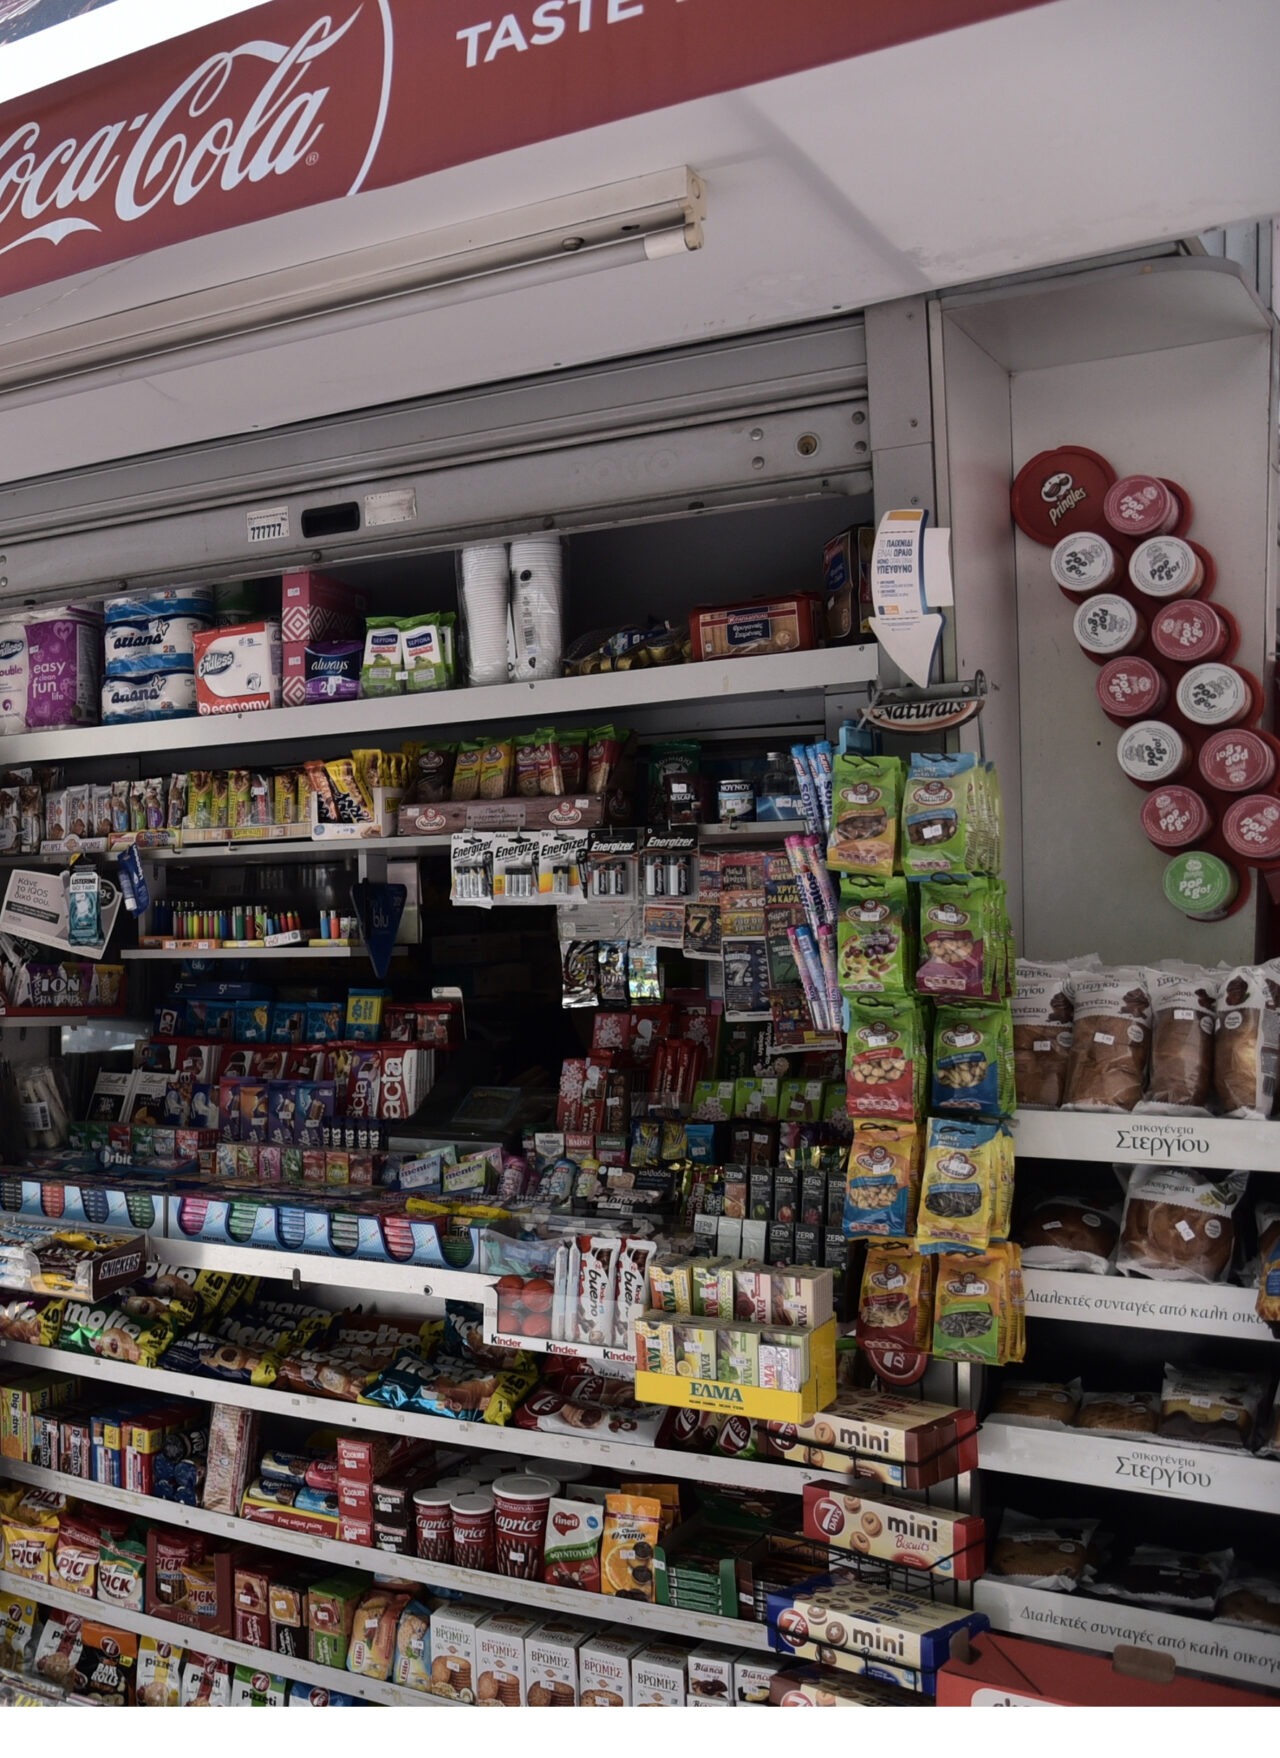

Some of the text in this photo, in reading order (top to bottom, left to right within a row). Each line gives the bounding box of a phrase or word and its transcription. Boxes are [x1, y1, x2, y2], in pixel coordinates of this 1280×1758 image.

[1049, 487, 1087, 526] Pringles
[877, 565, 913, 574] ΥΠΕΥΘΥΝΟ
[373, 636, 398, 645] SEPTONA
[406, 636, 432, 648] SEPTONA
[33, 661, 67, 677] easy
[198, 652, 234, 678] Endless
[311, 658, 350, 672] always
[33, 677, 57, 698] fun
[52, 692, 63, 700] life
[211, 700, 270, 714] economy
[452, 840, 494, 859] Energizer
[540, 837, 589, 857] Energizer
[590, 840, 635, 852] Energizer
[646, 836, 695, 849] Energizer
[18, 876, 39, 887] Κάνε
[14, 892, 31, 902] δικό
[27, 887, 49, 898] IQOS
[373, 912, 389, 927] blu
[382, 1056, 402, 1118] acta
[1132, 1124, 1194, 1137] οικογένεια
[1115, 1130, 1210, 1157] Στεργίου
[400, 1159, 438, 1178] mentos
[445, 1163, 484, 1181] mentos
[99, 1254, 141, 1279] SNICKERS
[1024, 1288, 1091, 1308] Διαλεκτές
[1094, 1297, 1156, 1316] συνταγές
[1159, 1303, 1186, 1317] από
[1190, 1306, 1227, 1321] καλή
[839, 1426, 890, 1453] mini
[1132, 1451, 1195, 1468] οικογένεια
[1115, 1456, 1211, 1488] Στεργίου
[26, 1487, 62, 1502] PICK
[416, 1513, 453, 1529] Caprice
[495, 1510, 542, 1532] Caprice
[819, 1502, 844, 1533] 7 DAYS
[887, 1514, 938, 1542] mini
[895, 1534, 930, 1552] Biscuits
[11, 1549, 42, 1566] PICK
[100, 1574, 131, 1594] PICK
[187, 1589, 215, 1604] PICK
[435, 1628, 472, 1645] ΒΡΩΜΗΣ
[1020, 1605, 1087, 1632] Διαλεκτές
[1090, 1622, 1154, 1646] συνταγές
[1157, 1632, 1186, 1652] από
[1189, 1640, 1228, 1659] καλή
[481, 1640, 520, 1659] ΒΡΩΜΗΣ
[853, 1628, 905, 1656] mini
[531, 1650, 570, 1668] ΒΡΩΜΗΣ
[584, 1659, 623, 1678] ΒΡΩΜΗΣ
[91, 1670, 118, 1687] ROLLS
[638, 1672, 679, 1692] ΒΡΩΜΗΣ
